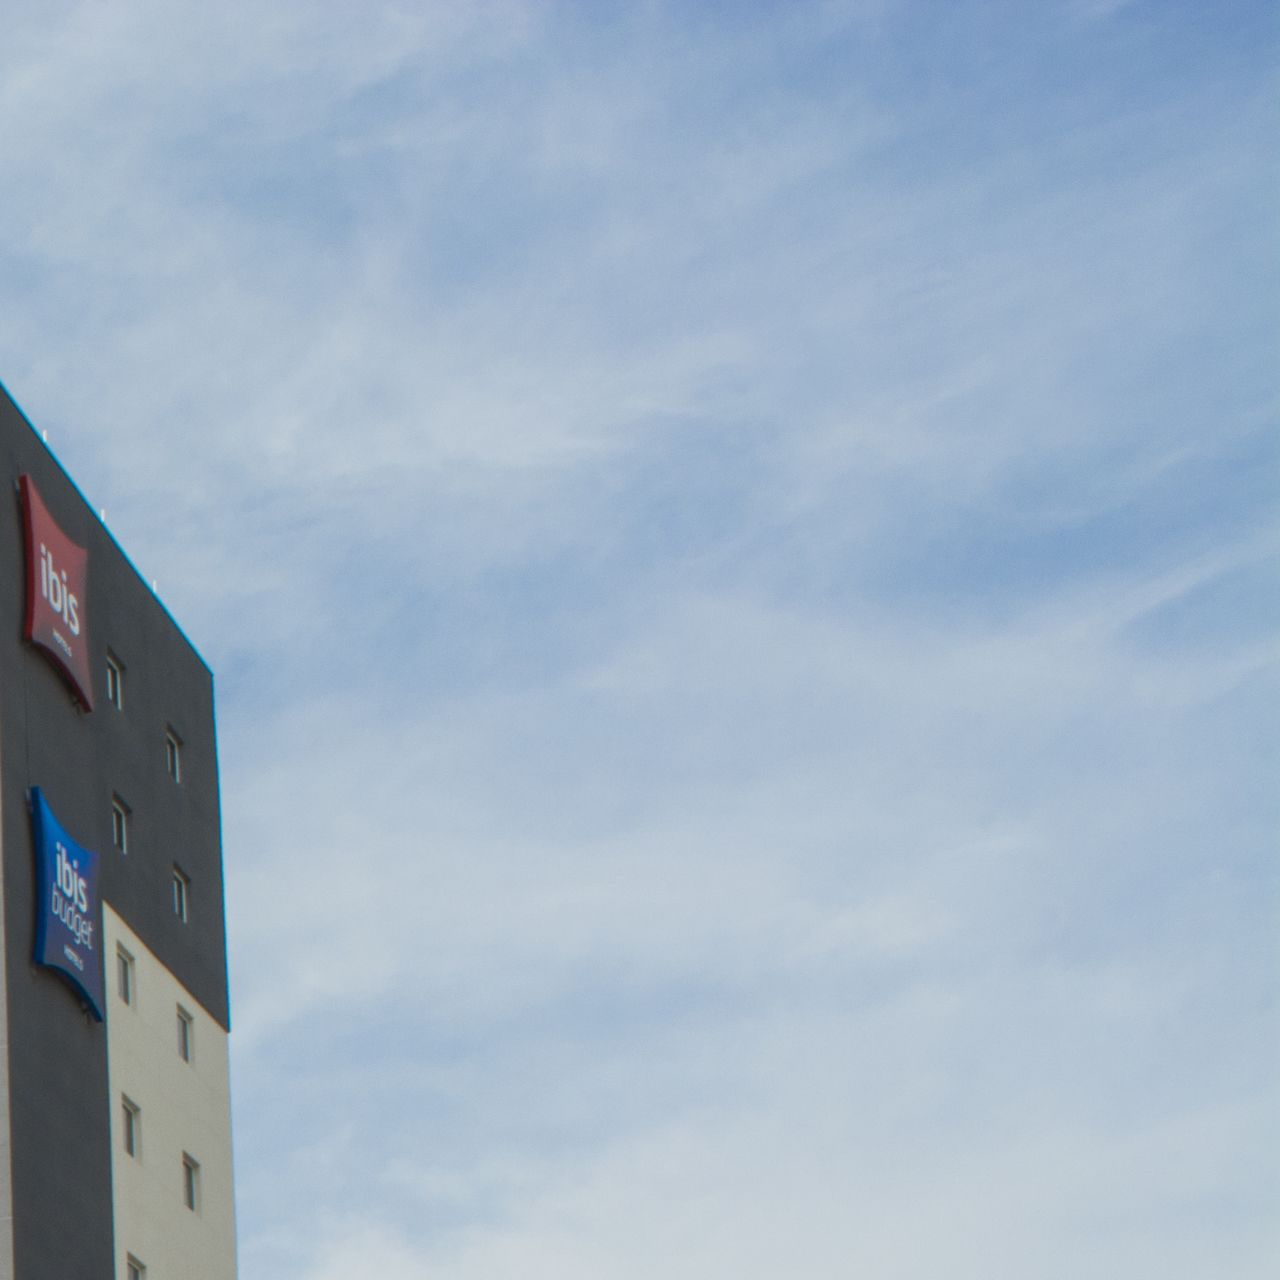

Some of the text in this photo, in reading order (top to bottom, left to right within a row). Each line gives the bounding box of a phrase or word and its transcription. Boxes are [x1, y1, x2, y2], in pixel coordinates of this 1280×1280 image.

[40, 541, 80, 636] ibis
[55, 841, 88, 913] ibis
[51, 883, 93, 950] budget
